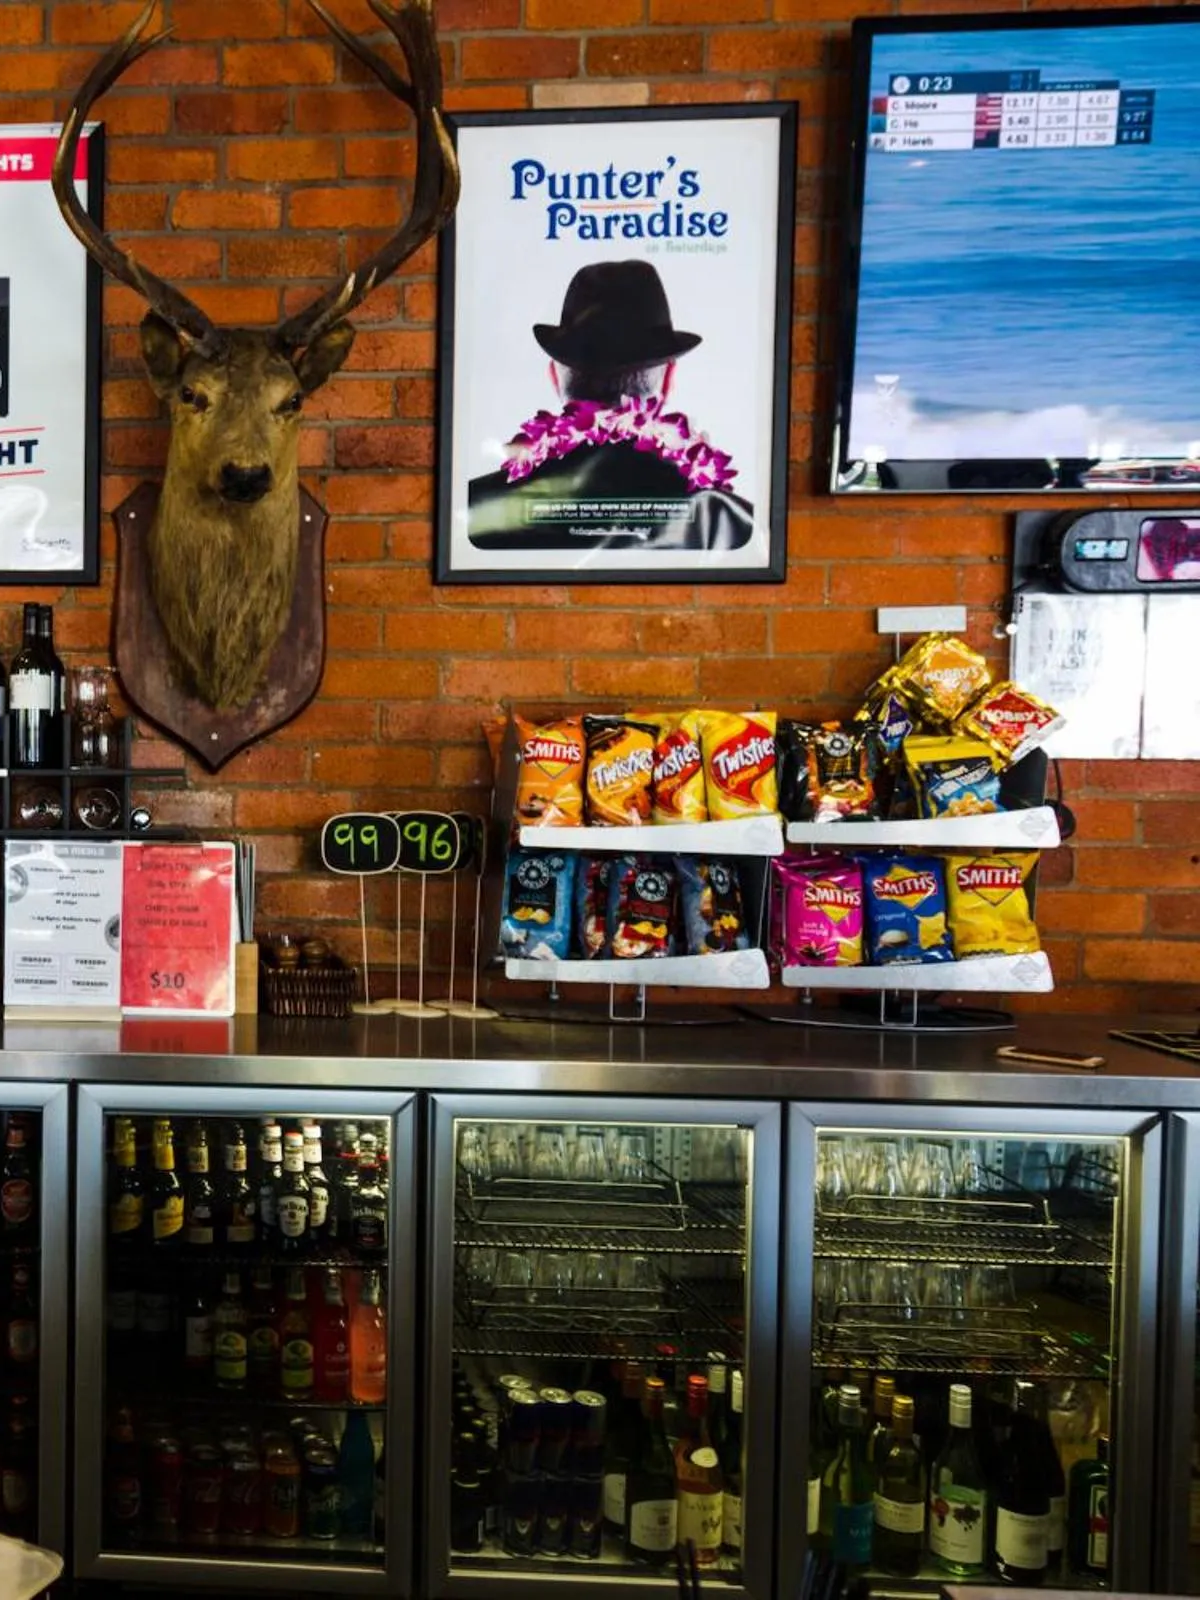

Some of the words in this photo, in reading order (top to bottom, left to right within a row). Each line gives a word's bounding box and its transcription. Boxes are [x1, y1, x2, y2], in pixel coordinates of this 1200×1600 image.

[919, 77, 952, 91] 0:23
[904, 99, 938, 110] Moore
[1006, 96, 1034, 108] 12.17
[903, 119, 919, 128] Ho
[510, 155, 701, 200] Punter's
[545, 200, 729, 240] Paradise
[551, 503, 562, 512] US
[563, 503, 578, 512] FOR
[579, 503, 599, 512] YOUR
[600, 503, 619, 512] OWN
[620, 503, 640, 512] SLICE
[642, 503, 652, 512] OF
[524, 740, 582, 762] SMITH'S
[654, 741, 701, 783] wisties
[592, 748, 654, 793] Twisties
[334, 823, 379, 864] 99
[403, 820, 452, 863] 96
[872, 871, 937, 896] SMITH'S
[804, 887, 862, 906] SMITH'S
[150, 970, 185, 989] $10
